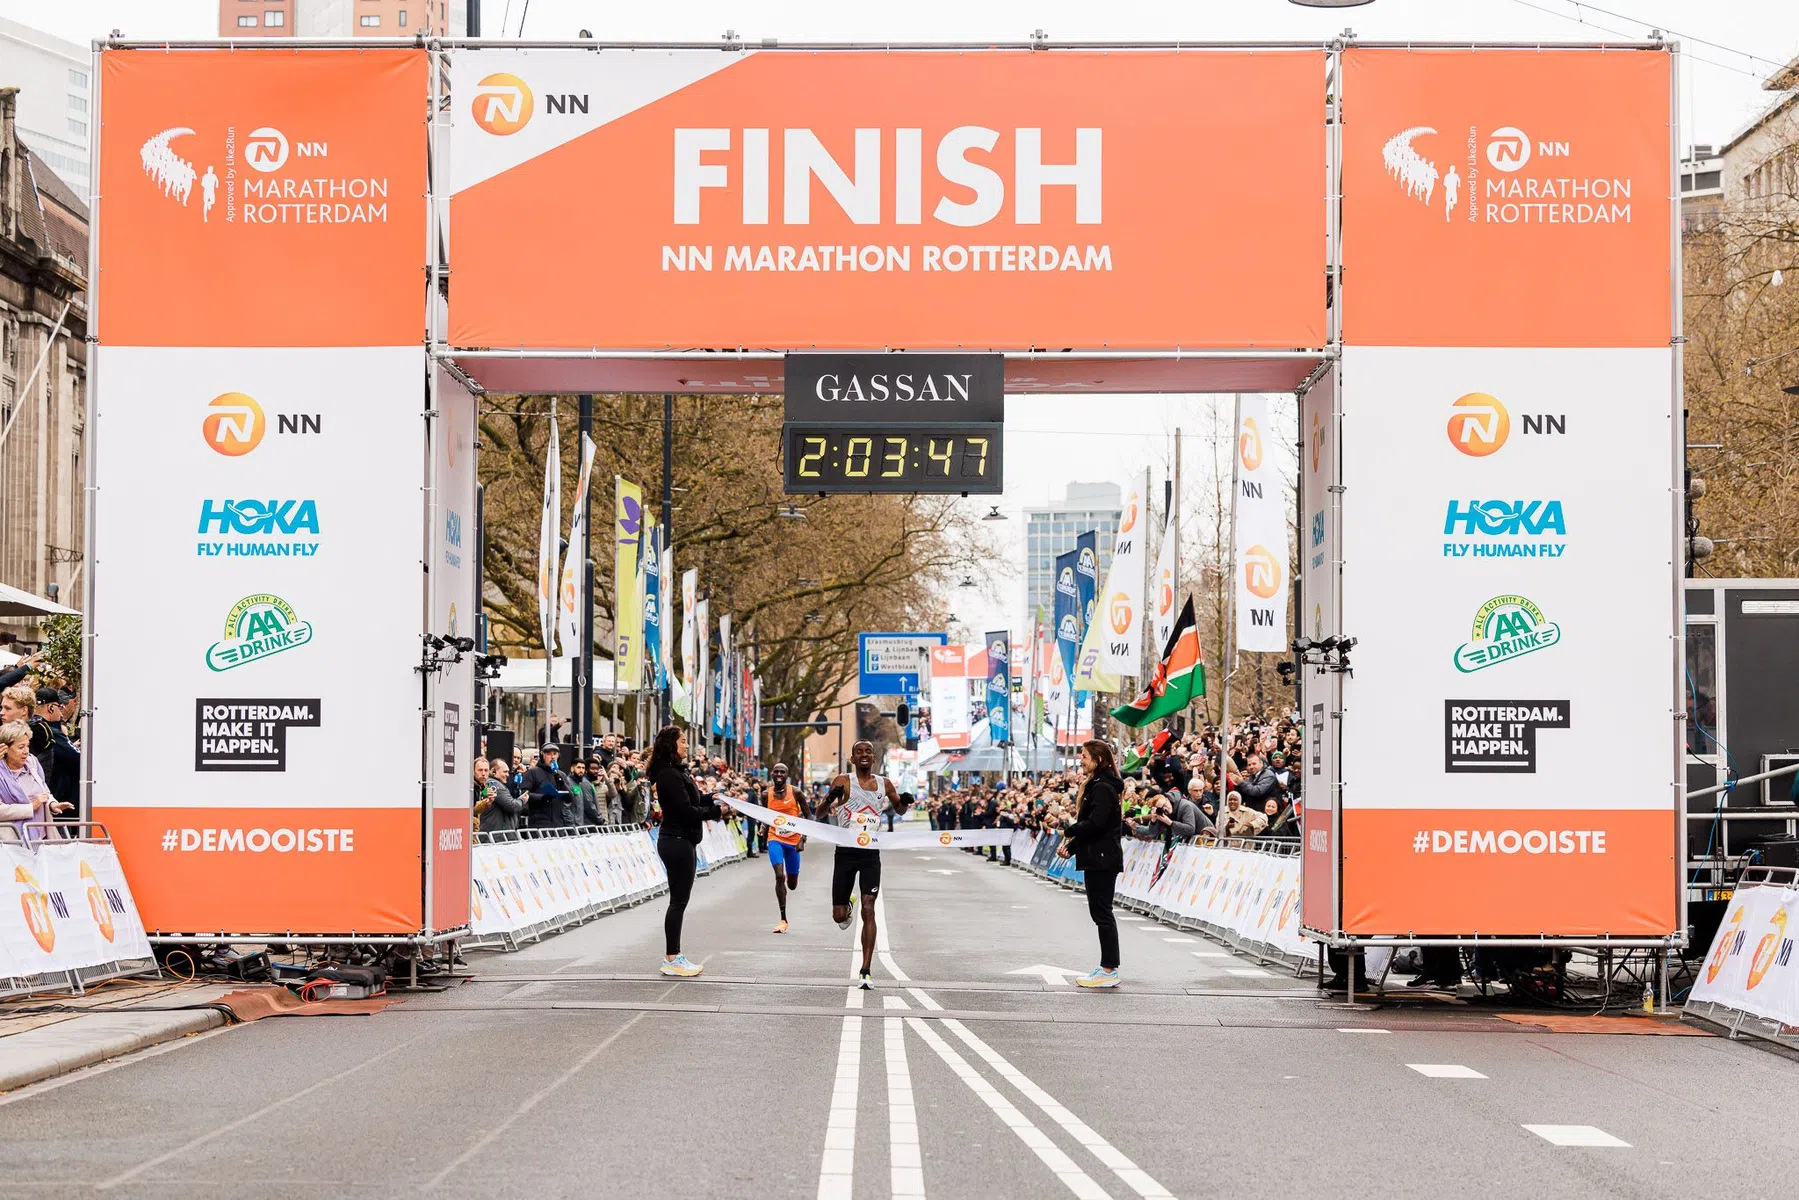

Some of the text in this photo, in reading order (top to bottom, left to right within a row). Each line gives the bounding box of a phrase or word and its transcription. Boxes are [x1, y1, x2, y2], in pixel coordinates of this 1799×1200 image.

[546, 95, 588, 114] NN
[297, 142, 327, 156] NN
[1539, 142, 1569, 156] NN
[226, 127, 236, 223] Approved by Like2Run
[674, 126, 1102, 227] FINISH
[1468, 126, 1478, 223] Approved by Like2Run
[244, 179, 387, 198] MARATHON
[1487, 179, 1630, 198] MARATHON
[244, 203, 387, 223] ROTTERDAM
[1487, 204, 1630, 223] ROTTERDAM
[662, 245, 1112, 272] NN MARATHON ROTTERDAM
[816, 374, 972, 401] GASSAN
[277, 414, 321, 434] NN
[1522, 415, 1565, 434] NN
[799, 437, 987, 476] 2:03:47
[1242, 479, 1263, 499] NN
[198, 499, 320, 535] HOKA
[1444, 500, 1566, 535] HOKA
[198, 543, 319, 556] FLY HUMAN FLY
[1444, 543, 1566, 557] FLY HUMAN FLY
[228, 596, 292, 628] ALL ACTIVITY DRINK
[1251, 608, 1274, 626] NN
[1475, 596, 1539, 630] ALL ACTIVITY DRINK
[246, 610, 285, 641] AA
[1494, 611, 1533, 642] AA
[240, 630, 294, 659] DRINK
[893, 646, 919, 654] Lijnbaa
[1487, 632, 1542, 660] DRINK
[880, 654, 910, 662] Lijnbaan
[203, 705, 314, 720] ROTTERDAM.
[1452, 706, 1563, 721] ROTTERDAM.
[203, 722, 275, 736] MAKE IT
[1452, 724, 1525, 738] MAKE IT
[203, 739, 279, 753] HAPPEN.
[1452, 740, 1529, 755] HAPPEN.
[162, 828, 353, 852] #DEMOOISTE
[1413, 829, 1606, 855] #DEMOOISTE
